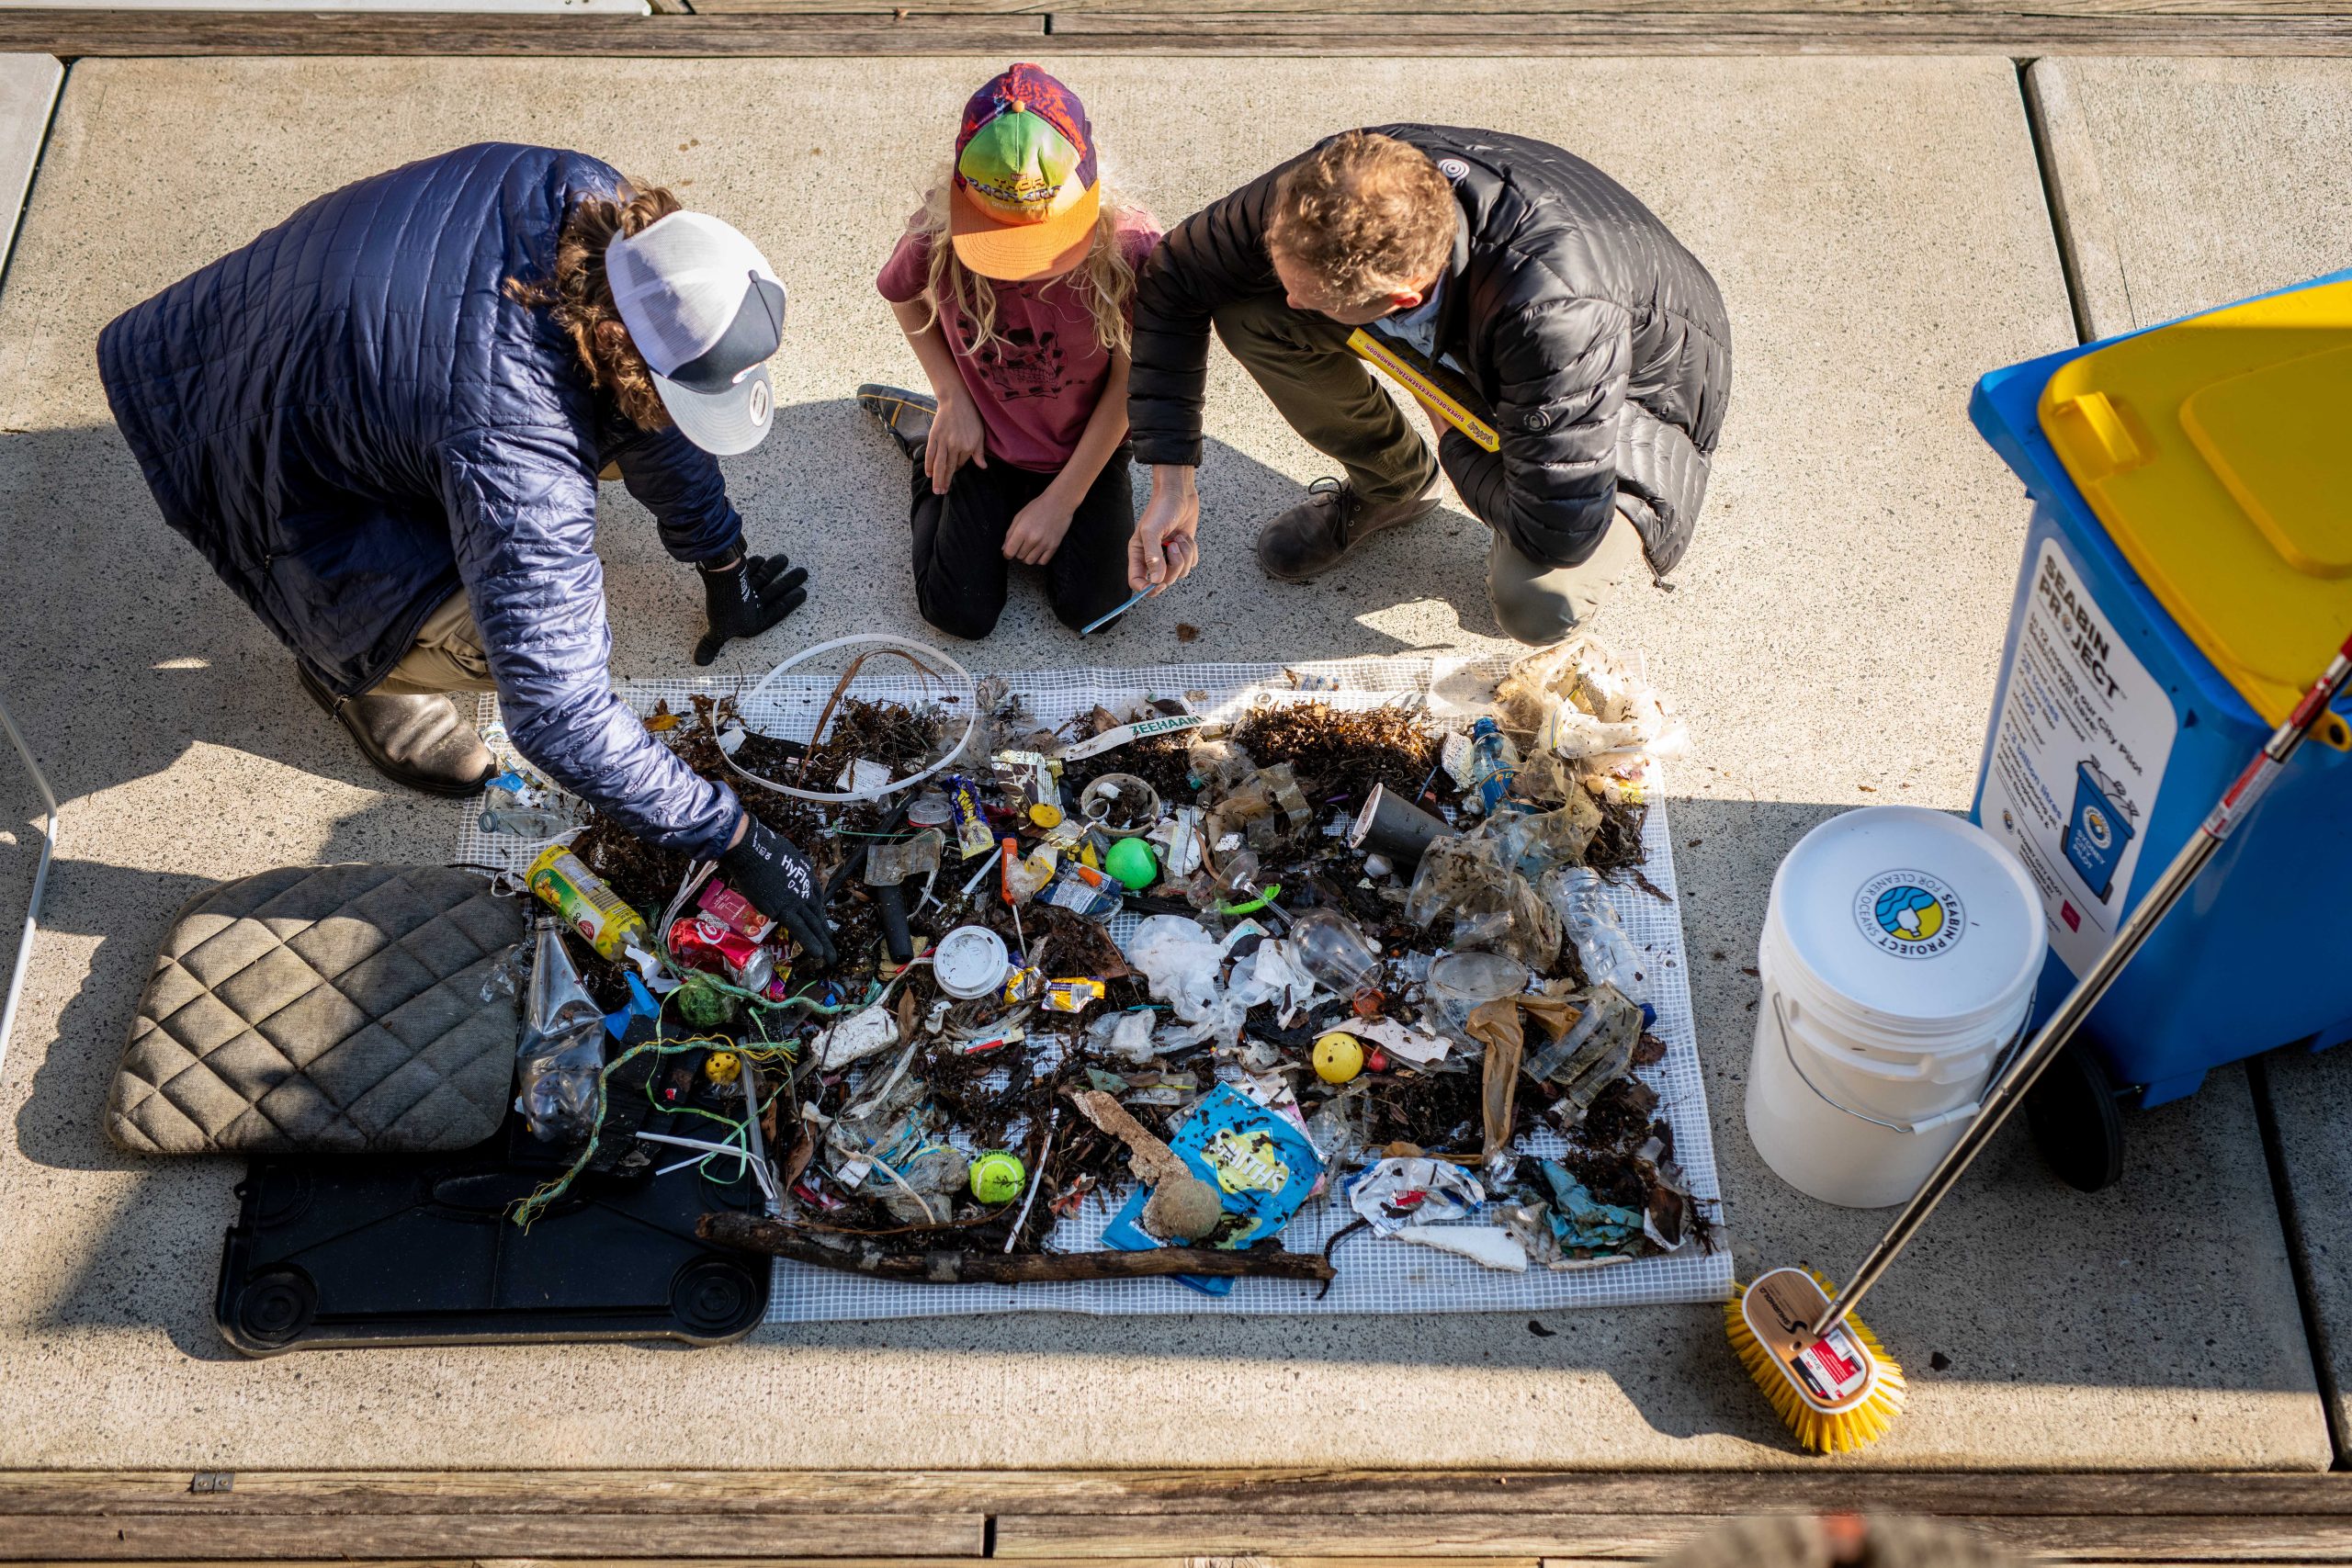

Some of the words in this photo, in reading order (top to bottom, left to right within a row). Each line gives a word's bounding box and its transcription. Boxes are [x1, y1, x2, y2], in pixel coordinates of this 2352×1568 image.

[2044, 555, 2110, 661] SEABIN
[1129, 716, 1200, 736] ZEEHAAN
[2050, 646, 2080, 694] months
[2080, 694, 2097, 717] our
[2098, 715, 2118, 748] City
[2119, 742, 2143, 775] Pilot
[2017, 741, 2041, 784] billion
[2041, 783, 2063, 820] litres
[781, 854, 810, 899] HyFlex
[1865, 874, 1916, 897] CLEANER
[1918, 875, 1943, 893] FOR
[1859, 897, 1881, 937] OCEANS
[1940, 893, 1961, 941] SEABIN
[1877, 936, 1948, 955] PROJECT
[1804, 1350, 1823, 1371] Brush
